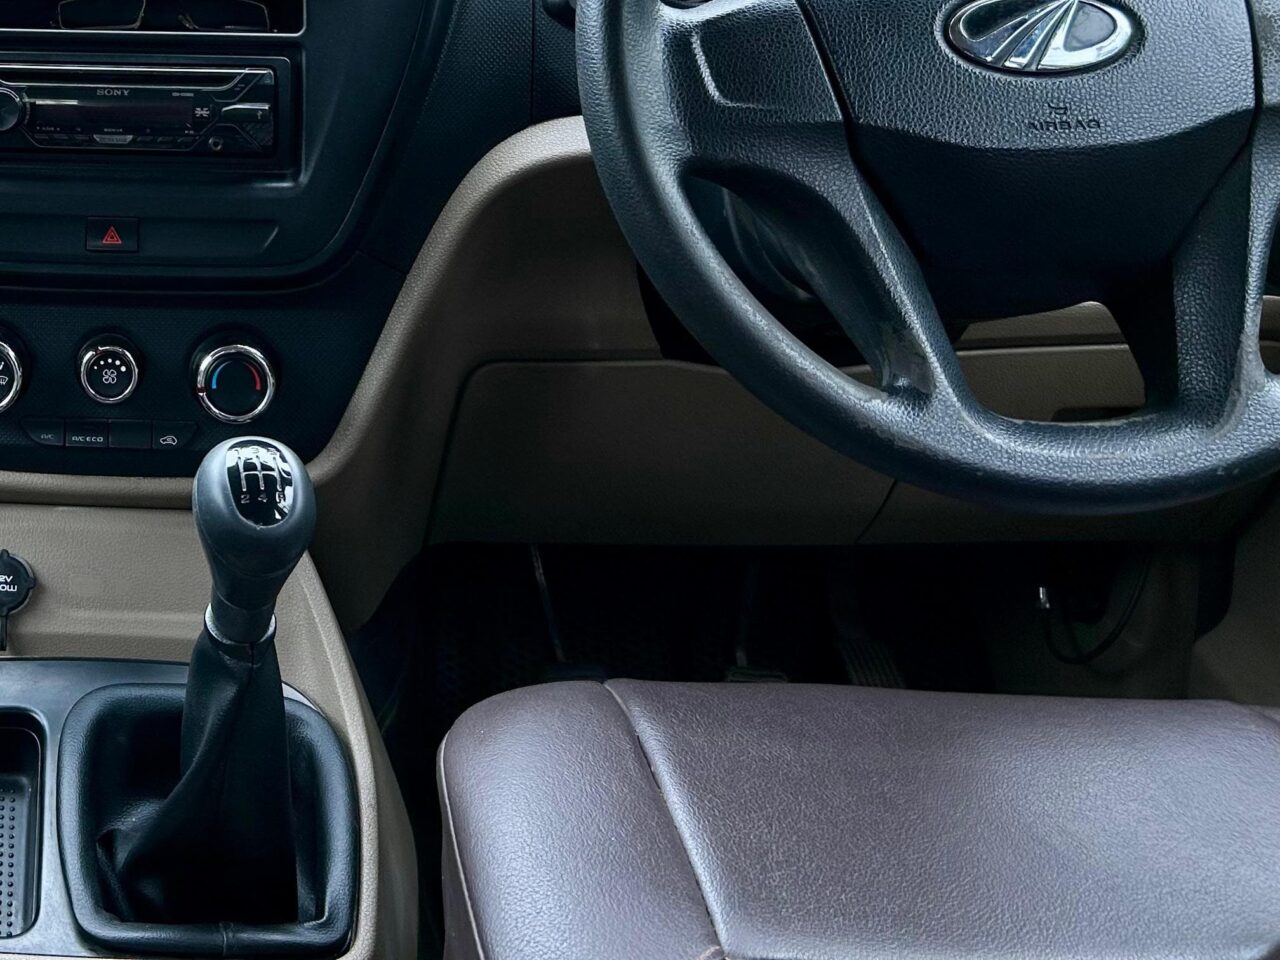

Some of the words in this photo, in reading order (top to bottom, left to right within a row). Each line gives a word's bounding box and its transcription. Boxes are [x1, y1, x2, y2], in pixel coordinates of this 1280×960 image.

[1028, 118, 1102, 132] AIRBAG
[240, 494, 250, 504] 2
[257, 493, 268, 503] 4
